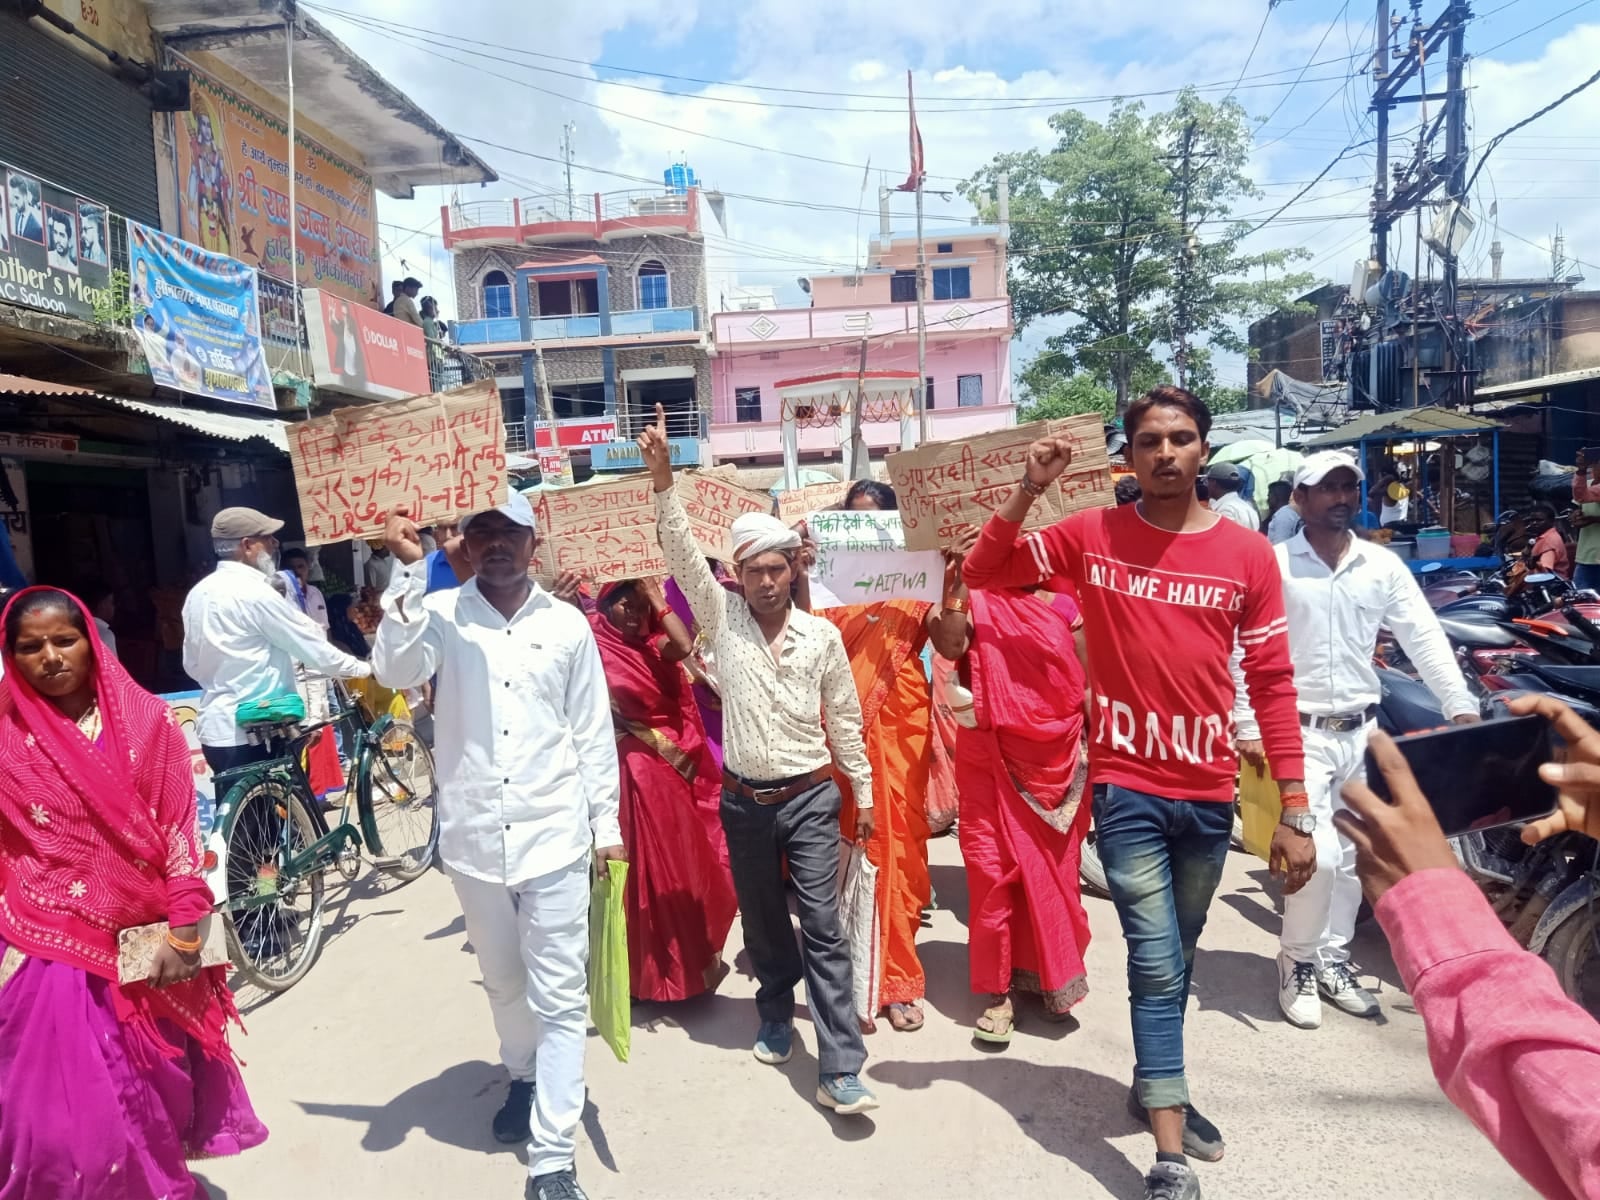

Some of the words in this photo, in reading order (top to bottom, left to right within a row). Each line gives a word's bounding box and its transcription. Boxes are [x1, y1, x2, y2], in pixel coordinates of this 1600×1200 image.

[20, 286, 66, 315] Saloon
[581, 428, 614, 443] ATM
[810, 513, 841, 535] पिंकी
[842, 513, 864, 534] देवी
[1128, 574, 1161, 600] WE
[1167, 581, 1226, 609] HAVE
